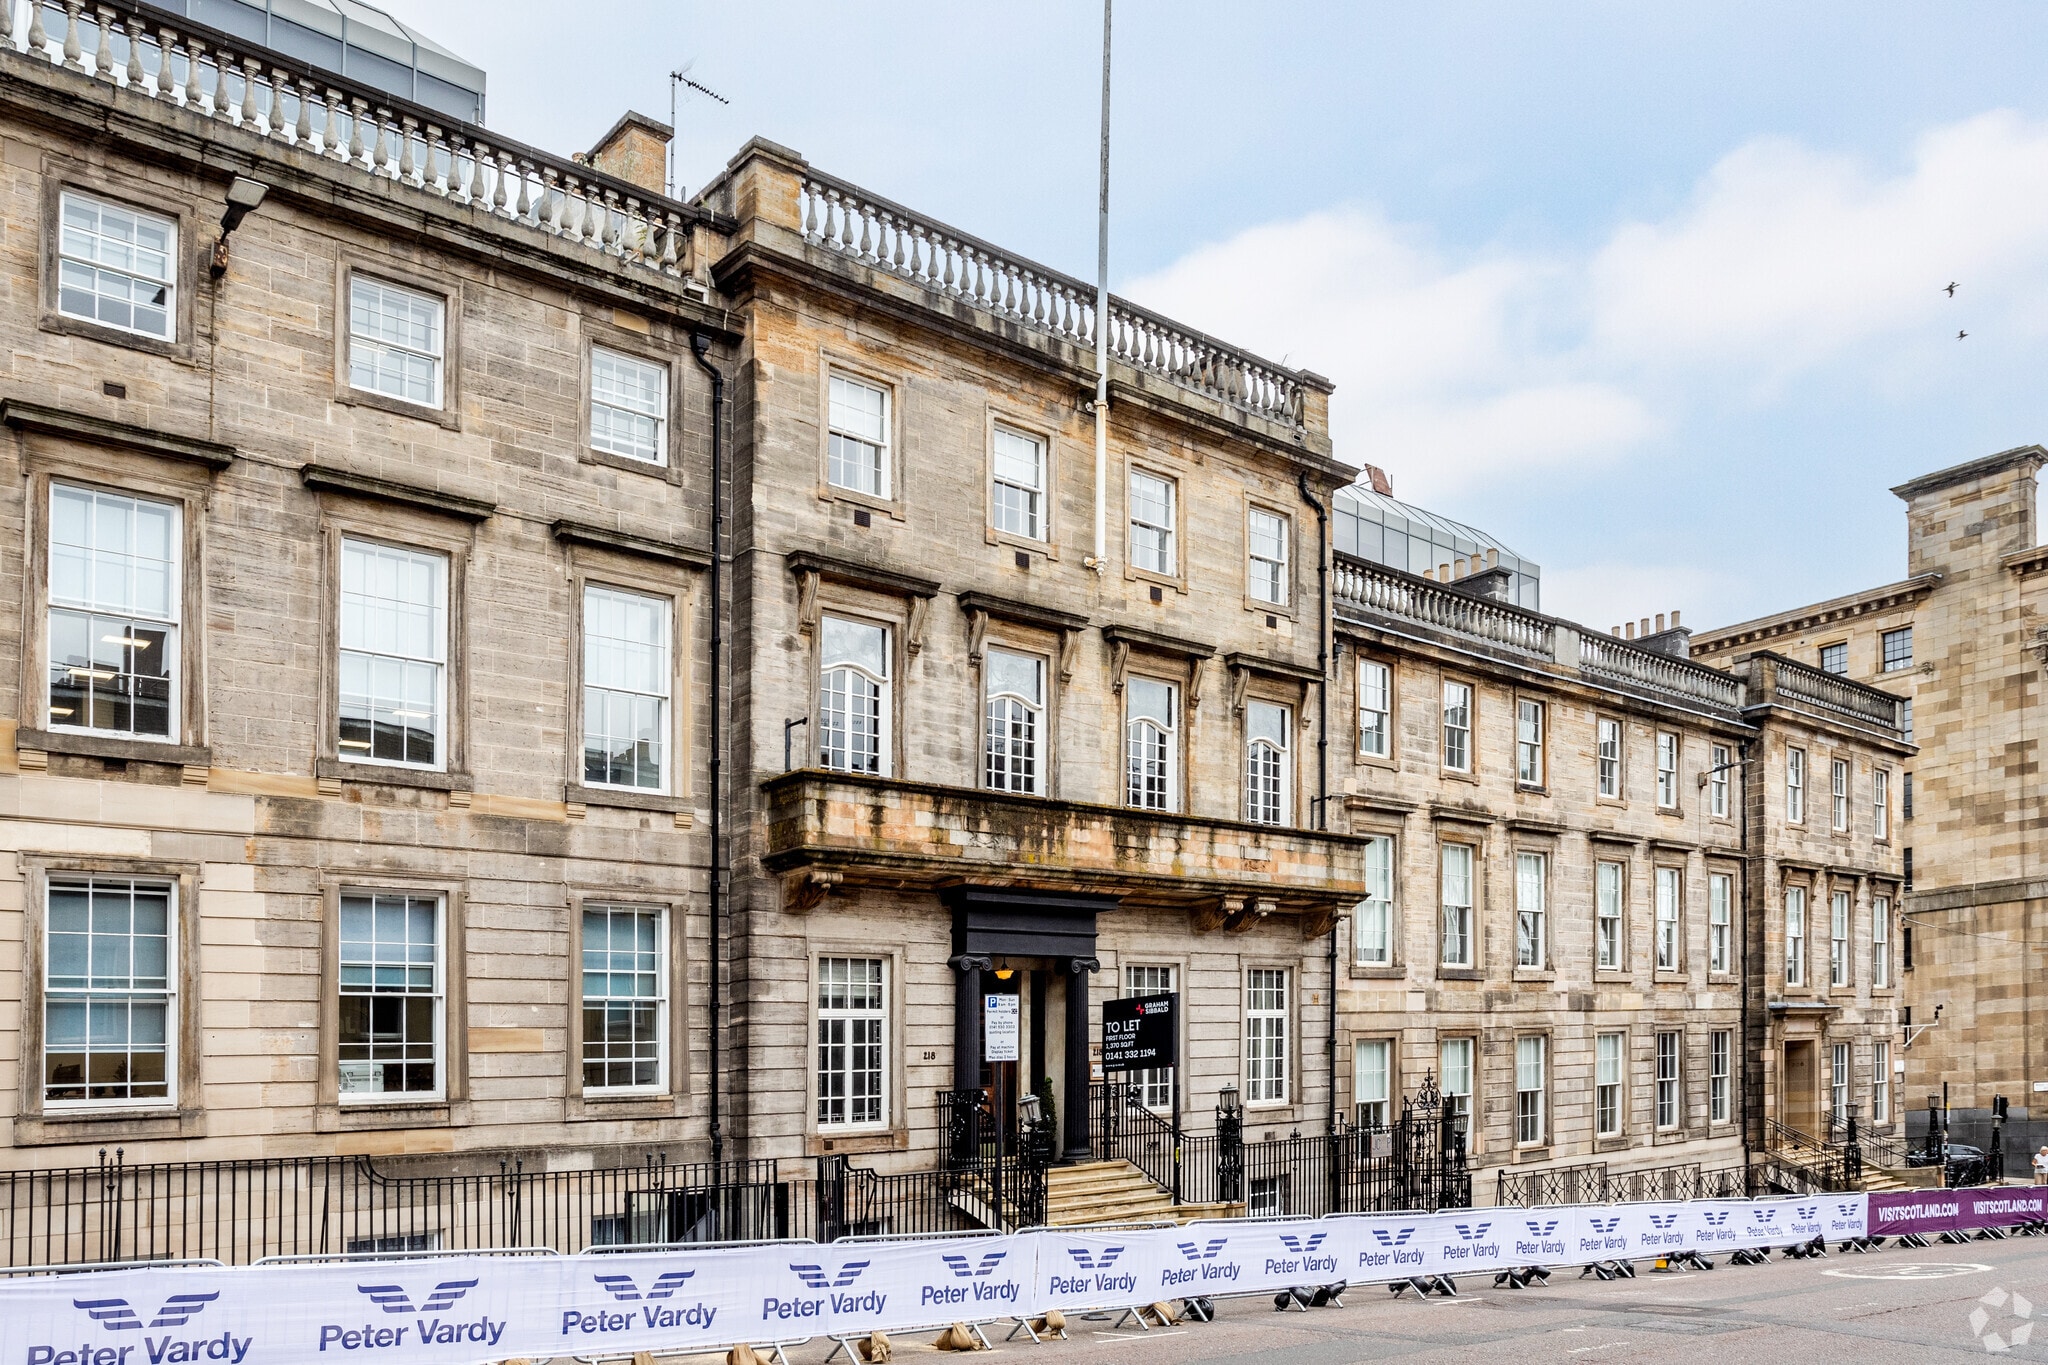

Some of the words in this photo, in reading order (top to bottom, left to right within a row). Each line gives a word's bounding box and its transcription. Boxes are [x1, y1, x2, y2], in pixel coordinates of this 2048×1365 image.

[1144, 1001, 1169, 1009] GRAHAM
[1145, 1007, 1169, 1015] SIBBALD
[1105, 1021, 1120, 1034] TO
[1123, 1019, 1141, 1032] LET
[1105, 1042, 1119, 1050] 1,370
[1105, 1051, 1123, 1060] 0141
[1124, 1049, 1138, 1059] 332
[1139, 1048, 1156, 1058] 1194
[923, 1051, 936, 1060] 218
[1878, 1203, 1959, 1222] VISITSCOTLAND.COM
[1973, 1199, 2043, 1215] VISITSCOTLAND.COM
[1832, 1220, 1847, 1231] Peter
[1848, 1219, 1863, 1230] Vardy
[1641, 1233, 1661, 1246] Peter
[1664, 1232, 1684, 1245] Vardy
[1696, 1230, 1714, 1241] Peter
[1716, 1228, 1737, 1241] Vardy
[1443, 1245, 1470, 1260] Peter
[1473, 1242, 1499, 1258] Vardy
[1516, 1241, 1540, 1255] Peter
[1542, 1239, 1566, 1255] Vardy
[1580, 1238, 1602, 1252] Peter
[1605, 1236, 1627, 1250] Vardy
[1265, 1259, 1299, 1275] Peter
[1303, 1255, 1338, 1273] Vardy
[1359, 1252, 1390, 1267] Peter
[1393, 1248, 1425, 1265] Vardy
[1162, 1268, 1197, 1286] Peter
[1202, 1262, 1241, 1281] Vardy
[1050, 1276, 1091, 1295] Peter
[1095, 1272, 1137, 1293] Vardy
[922, 1285, 968, 1306] Peter
[973, 1280, 1020, 1302] Vardy
[763, 1298, 825, 1320] Peter
[830, 1290, 887, 1315] Vardy
[562, 1310, 636, 1335] Peter
[643, 1303, 717, 1329] Vardy
[319, 1324, 408, 1351] Peter
[417, 1316, 506, 1346] Vardy
[27, 1344, 135, 1365] Peter
[144, 1332, 253, 1364] Vardy
